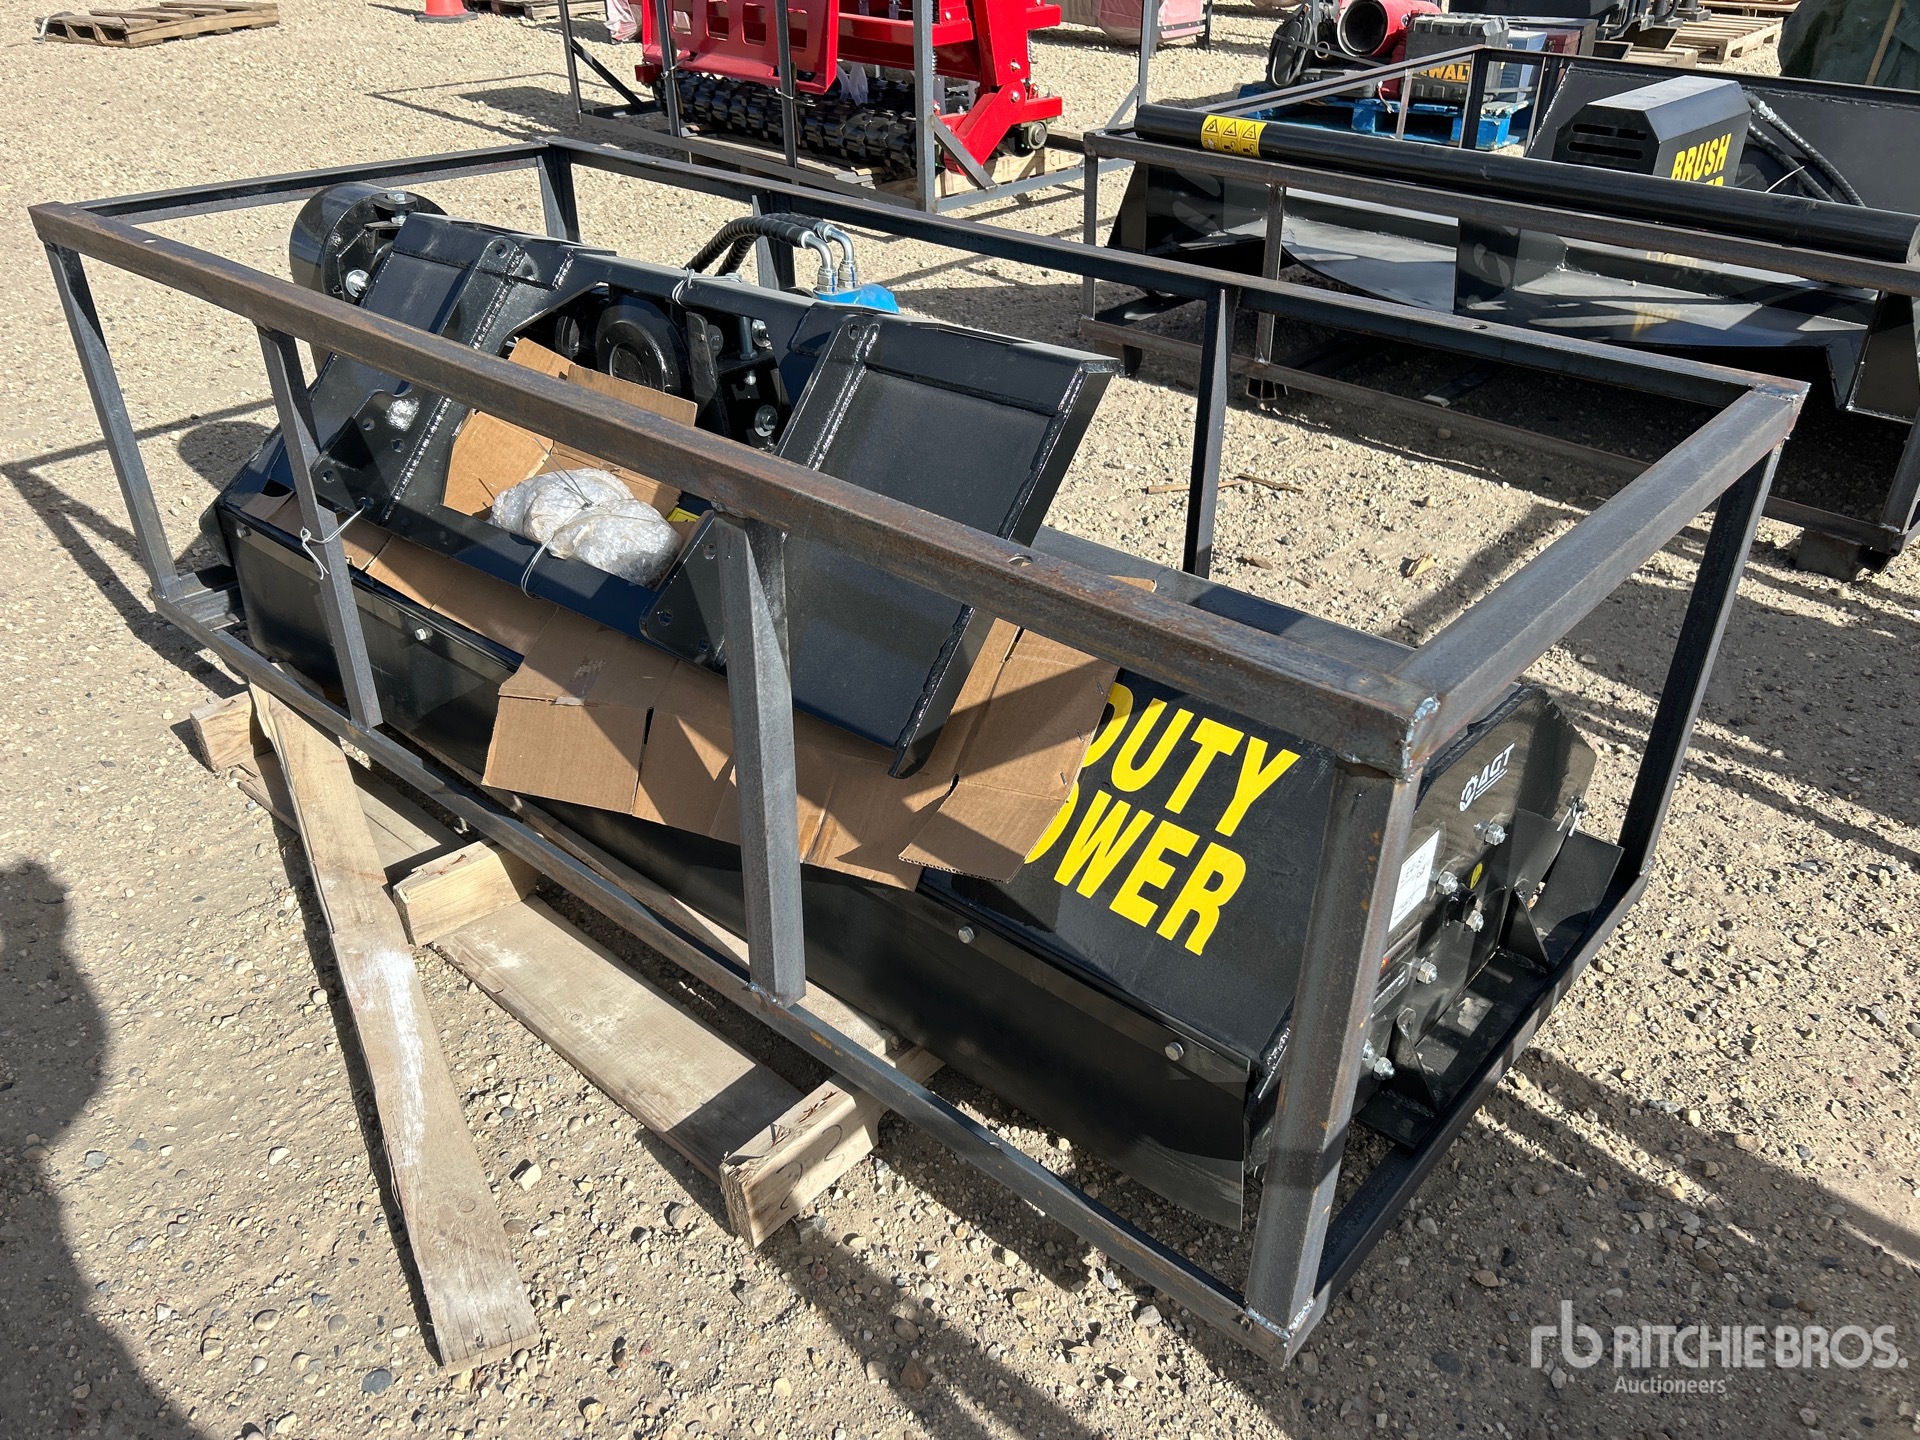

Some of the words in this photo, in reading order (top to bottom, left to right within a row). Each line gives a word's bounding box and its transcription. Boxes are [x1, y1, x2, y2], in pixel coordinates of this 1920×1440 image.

[1418, 64, 1471, 81] WALT
[1671, 133, 1732, 182] BRUSH
[1477, 743, 1515, 789] AGT
